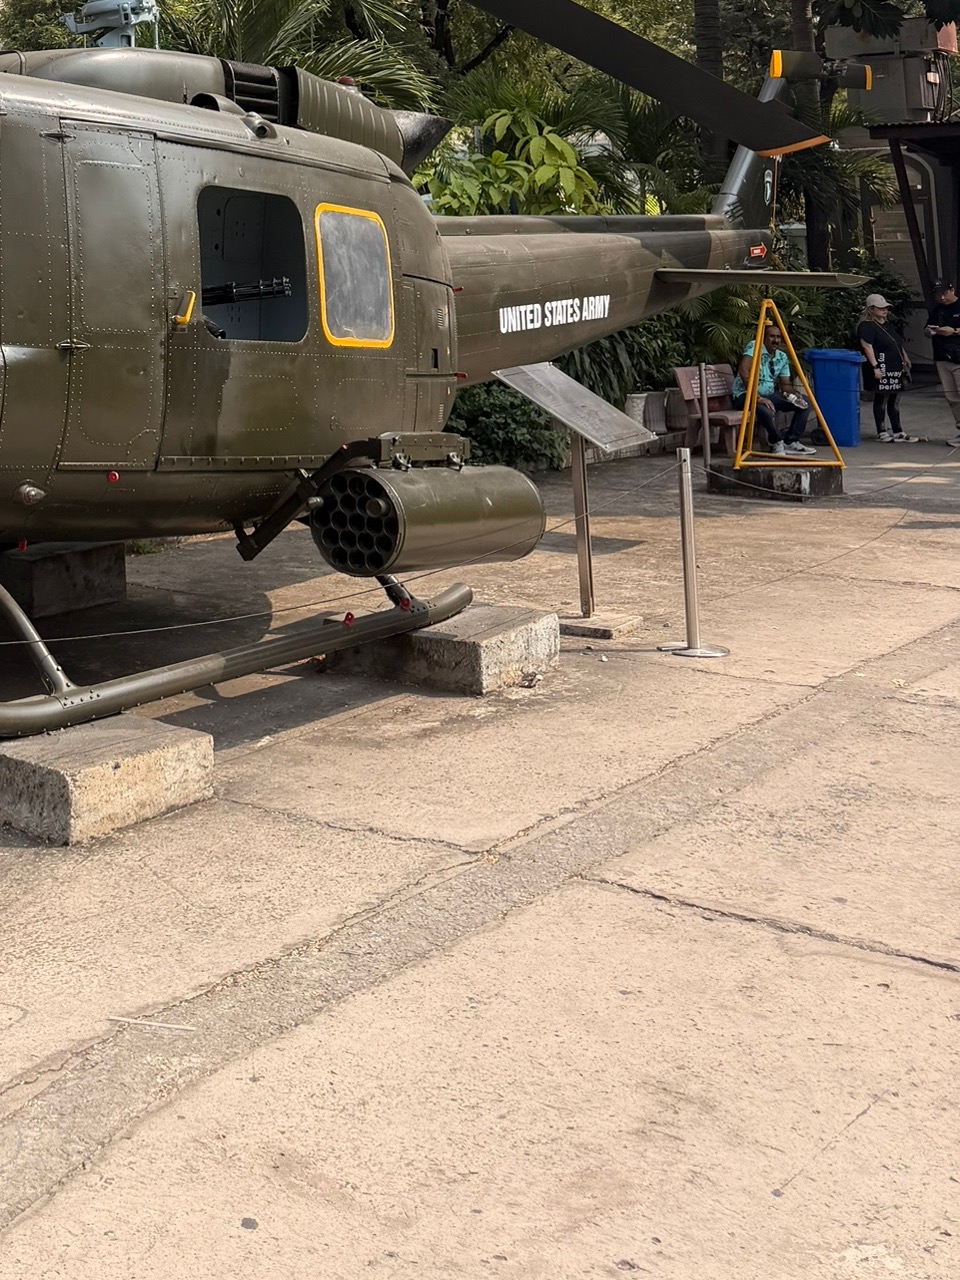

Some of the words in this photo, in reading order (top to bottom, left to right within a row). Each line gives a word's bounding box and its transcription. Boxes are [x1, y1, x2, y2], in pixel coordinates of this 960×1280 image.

[499, 304, 542, 334] UNITED
[544, 297, 581, 327] STATES
[581, 294, 611, 321] ARMY
